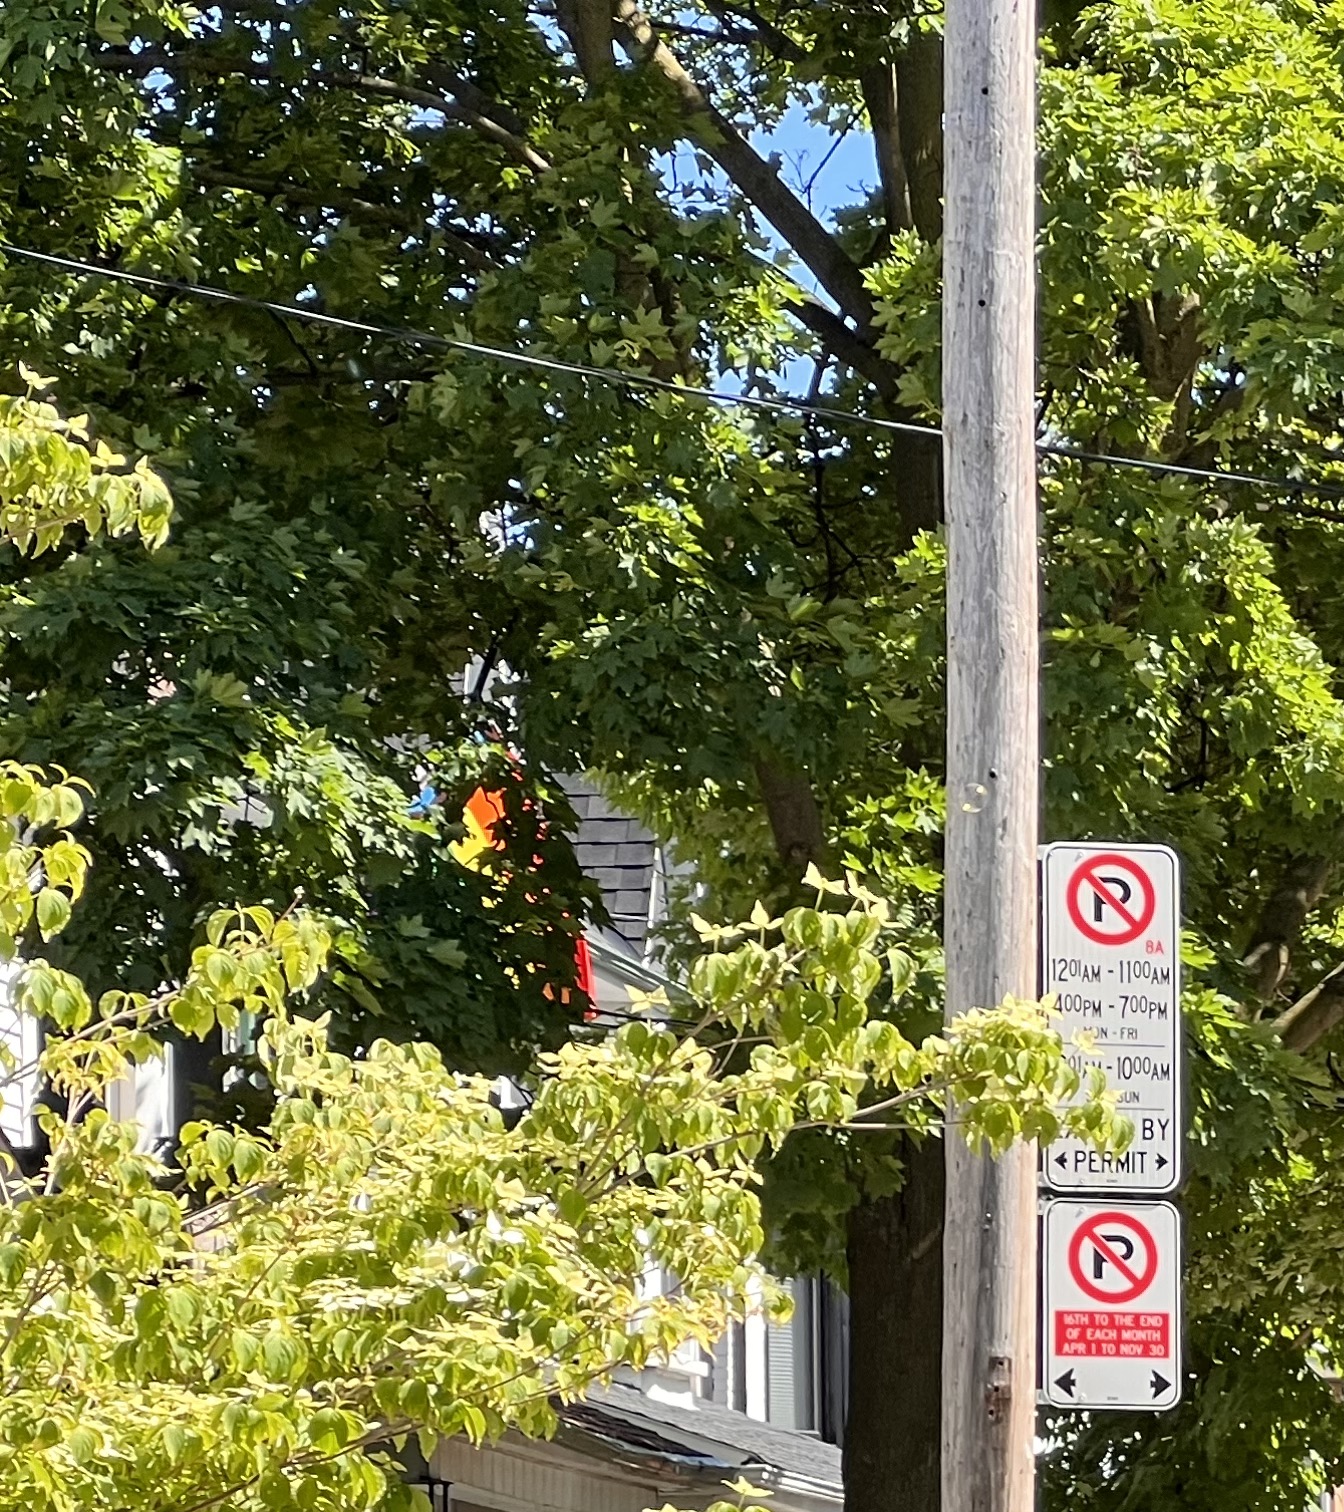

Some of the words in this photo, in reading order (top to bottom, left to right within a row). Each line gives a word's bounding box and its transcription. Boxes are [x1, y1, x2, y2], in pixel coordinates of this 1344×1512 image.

[1120, 1027, 1138, 1040] FRI
[1142, 1118, 1170, 1141] BY
[1074, 1150, 1147, 1173] PERMIT
[1063, 1313, 1089, 1325] 16TH
[1094, 1314, 1109, 1326] TO
[1113, 1315, 1135, 1327] THE
[1140, 1315, 1163, 1328] END
[1066, 1328, 1081, 1340] OF
[1086, 1328, 1117, 1341] EACH
[1122, 1329, 1161, 1342] MONTH
[1063, 1342, 1086, 1355] APR
[1101, 1343, 1117, 1355] TO
[1120, 1344, 1144, 1356] NOV
[1149, 1345, 1165, 1357] 30
